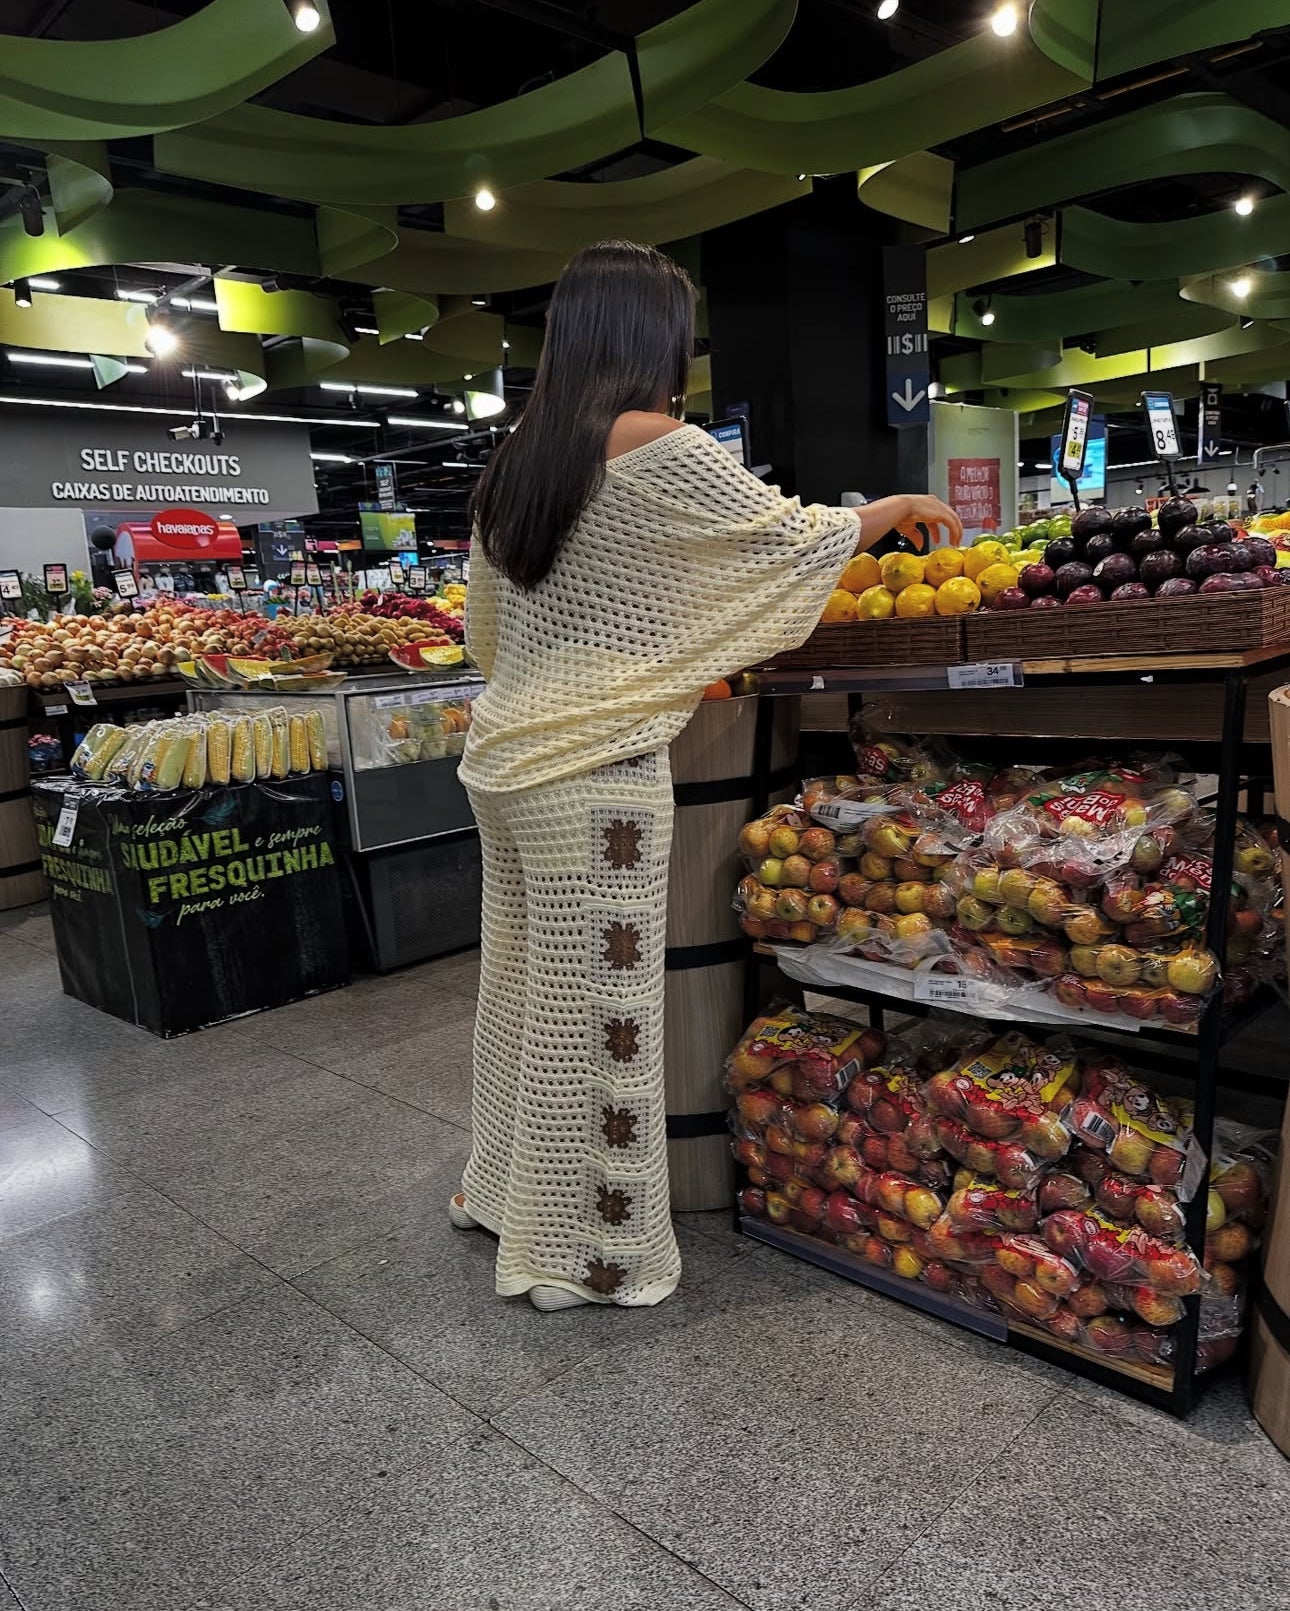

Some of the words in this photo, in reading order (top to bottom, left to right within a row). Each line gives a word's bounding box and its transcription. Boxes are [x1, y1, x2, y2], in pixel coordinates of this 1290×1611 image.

[886, 292, 926, 304] CONSULTE
[889, 304, 896, 313] O
[897, 303, 923, 313] PREÇO
[897, 313, 916, 322] AQUI
[718, 427, 741, 439] CONFIRA
[1156, 430, 1166, 450] 8
[80, 449, 129, 471] SELF
[134, 451, 241, 476] CHECKOUTS
[52, 482, 110, 500] CAIXAS
[112, 484, 132, 501] DE
[136, 484, 269, 504] AUTOATENDIMENTO
[156, 521, 214, 537] havaianas
[986, 666, 999, 676] 34
[131, 814, 187, 840] seleção
[254, 837, 264, 848] e
[267, 824, 322, 850] sempre
[148, 841, 335, 904] FRESQUINHA
[176, 898, 225, 926] para
[229, 885, 265, 905] você.
